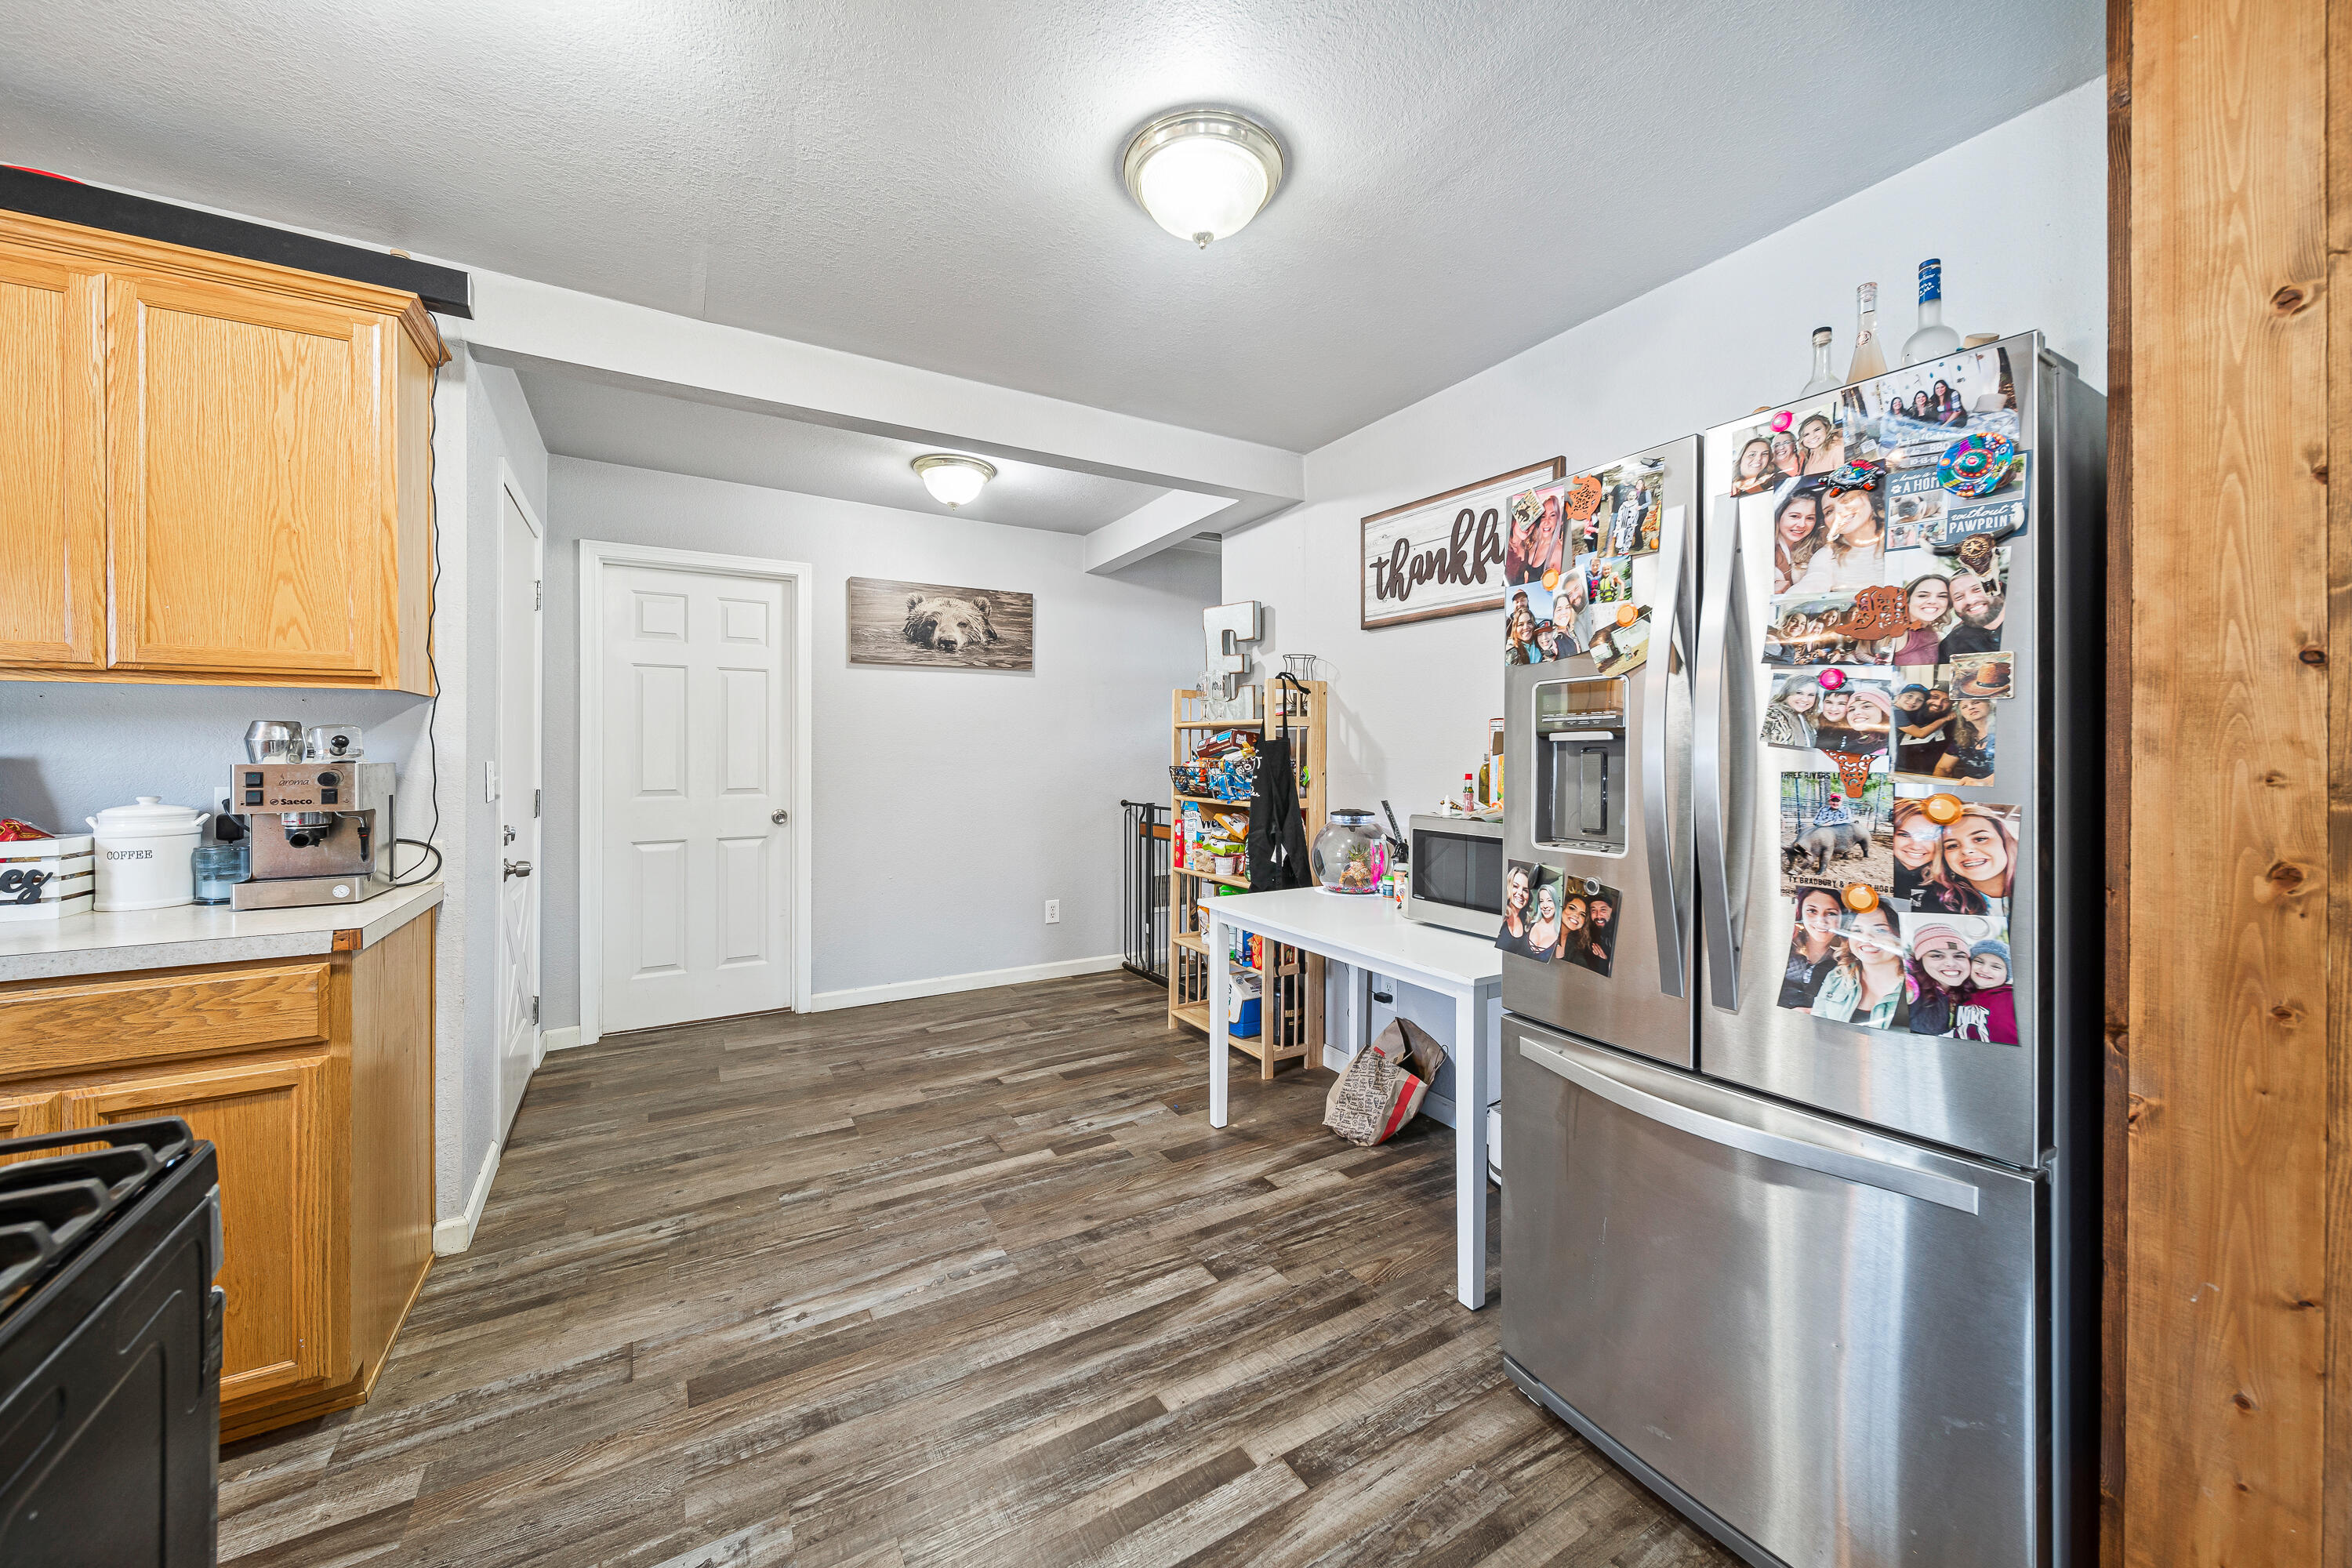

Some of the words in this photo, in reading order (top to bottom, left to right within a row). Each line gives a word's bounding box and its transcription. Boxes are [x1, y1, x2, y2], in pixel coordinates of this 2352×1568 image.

[1902, 481, 1911, 494] A
[1914, 477, 1940, 492] HOM
[1951, 504, 2009, 521] without
[1949, 513, 2016, 534] PAWPRINT
[1370, 508, 1505, 601] thankfu
[107, 850, 153, 860] COFFEE
[1799, 877, 1837, 888] BRADBURY
